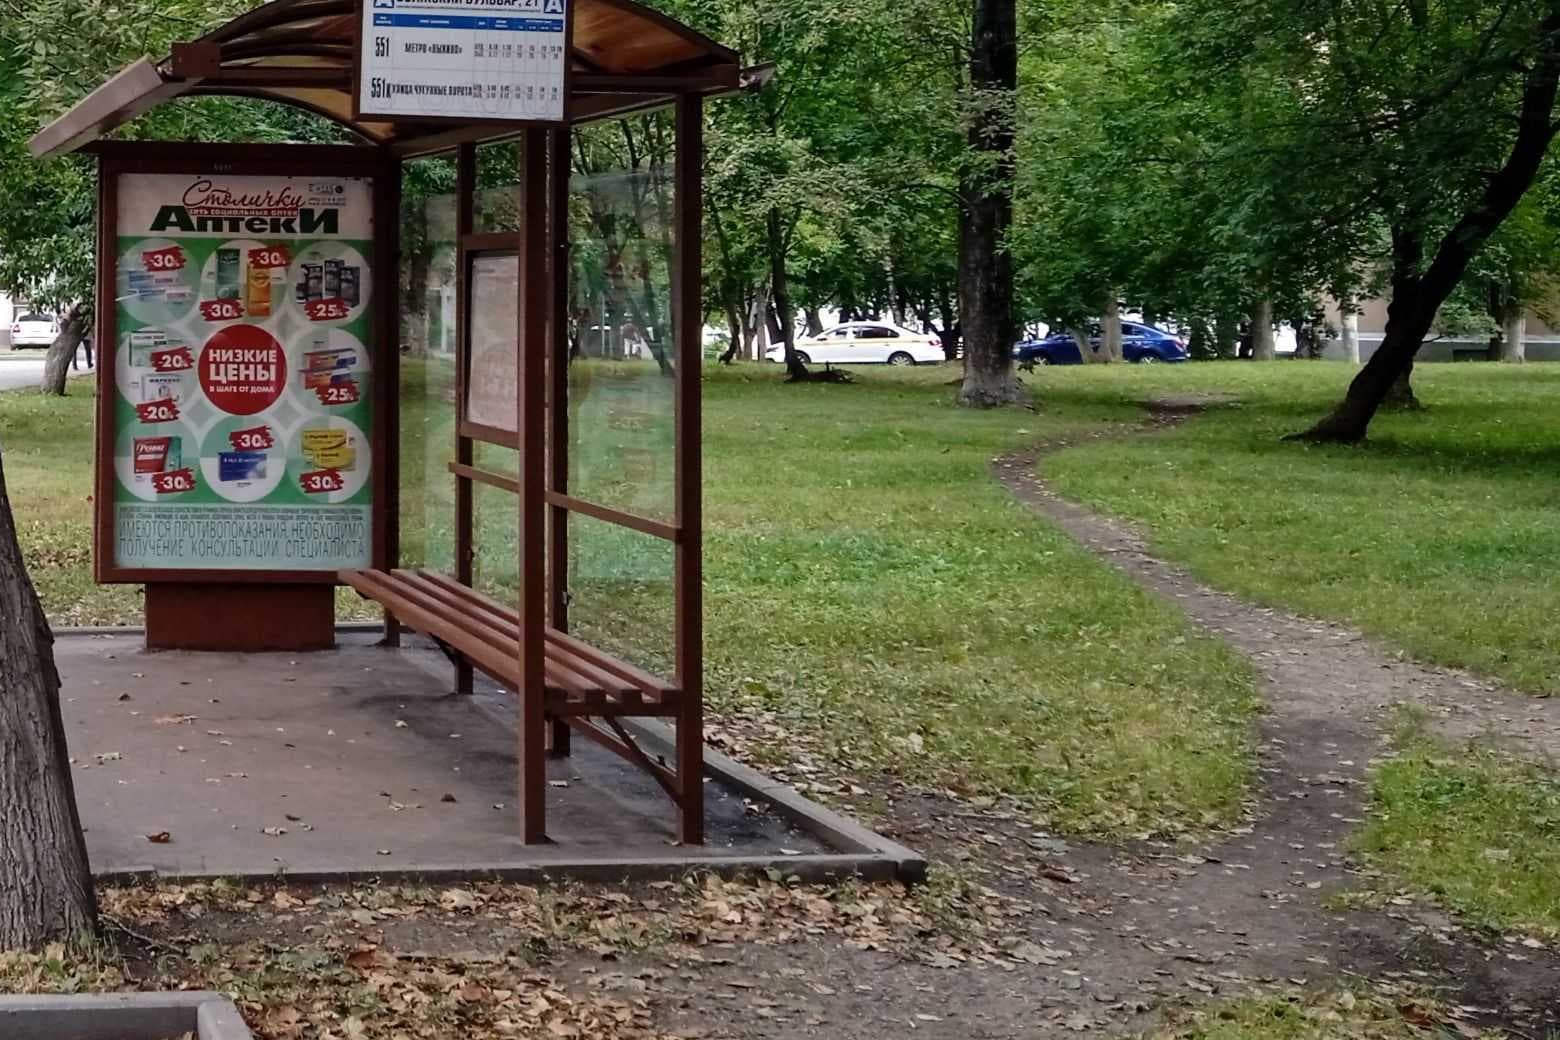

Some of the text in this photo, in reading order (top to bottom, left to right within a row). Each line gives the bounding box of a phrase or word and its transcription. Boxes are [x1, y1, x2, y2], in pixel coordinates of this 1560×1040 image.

[375, 36, 390, 57] 551
[404, 42, 427, 53] МЕТРО
[182, 179, 306, 208] Столички
[208, 349, 277, 363] НИЗКИЕ
[209, 363, 277, 384] ЦЕНЫ
[216, 385, 237, 393] ШАГЕ
[250, 385, 276, 394] ДОМА
[119, 520, 171, 538] ИМЕЮТСЯ
[292, 521, 365, 540] НЕОБХОДИМО
[119, 538, 365, 559] ПОЛУЧЕНИЕ КОНСУЛЬТАЦИИ СПЕЦИАЛИСТА
